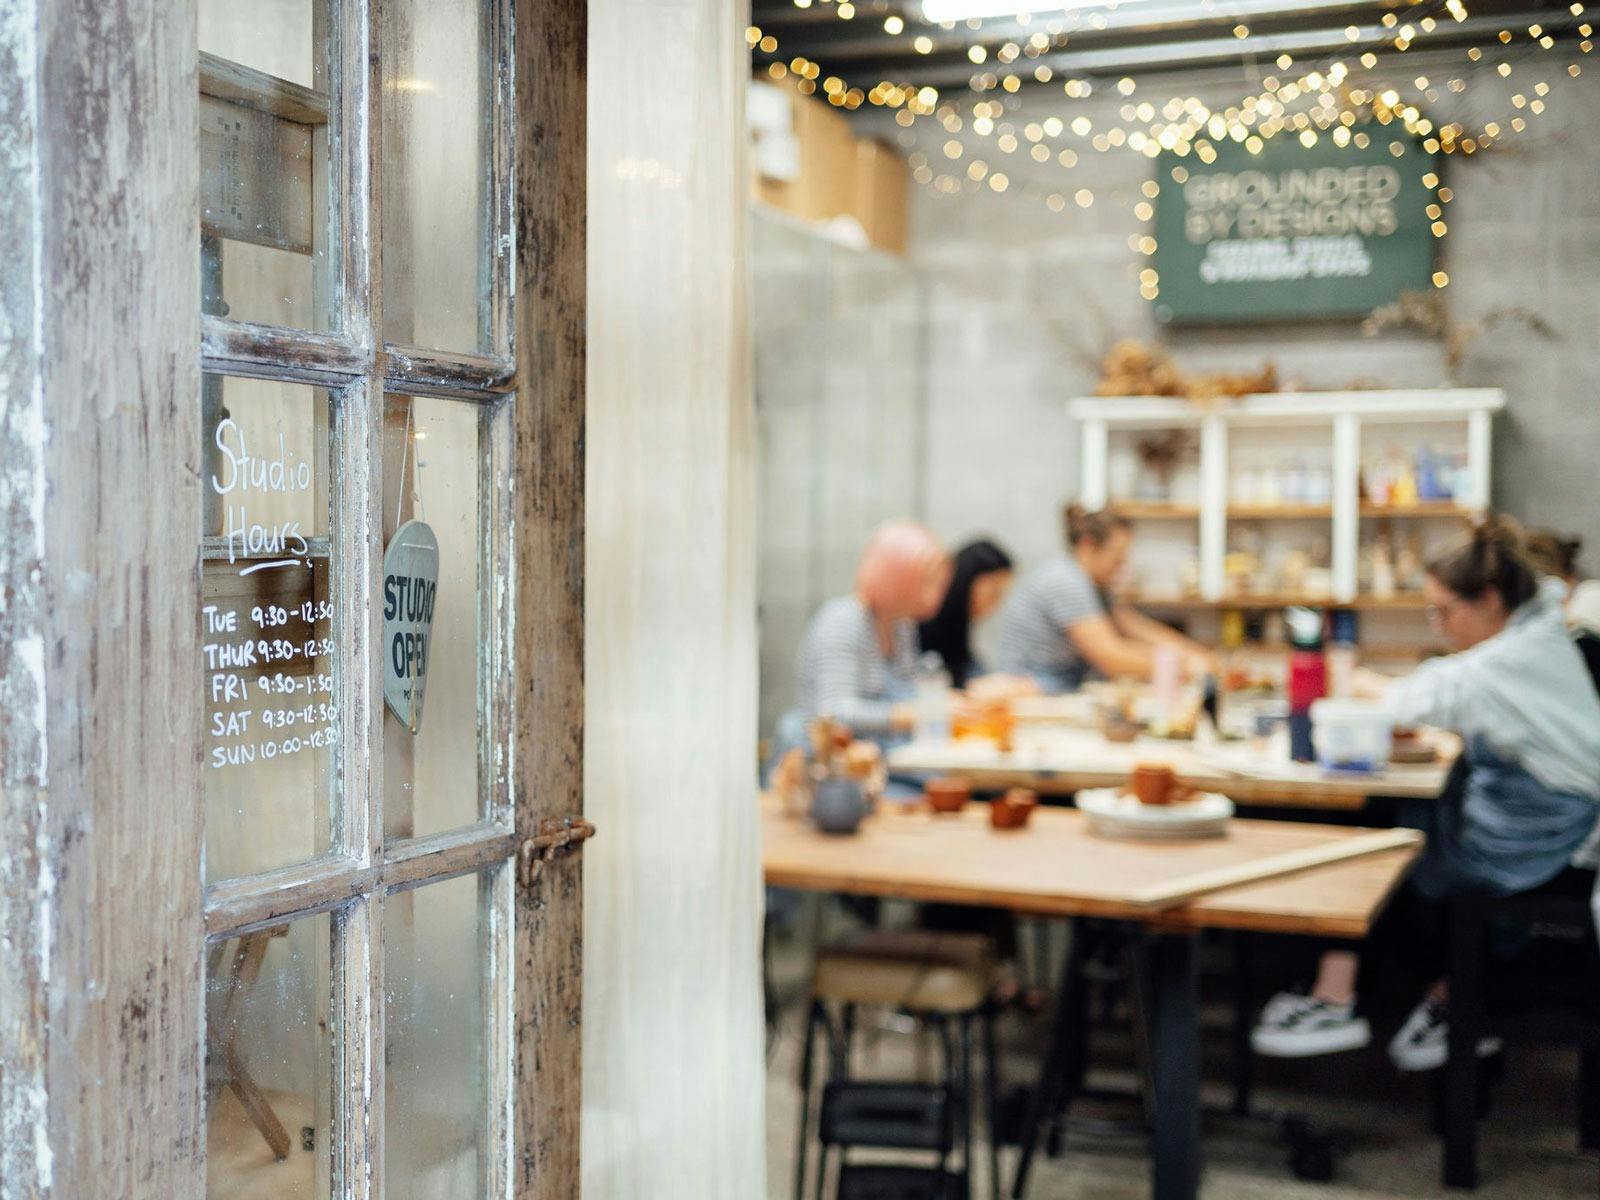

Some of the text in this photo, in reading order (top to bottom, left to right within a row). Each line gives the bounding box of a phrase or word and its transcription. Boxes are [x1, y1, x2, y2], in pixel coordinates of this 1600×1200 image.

[1184, 165, 1400, 210] GROUNDED
[1185, 205, 1236, 244] BY
[212, 418, 310, 495] Studio
[228, 505, 308, 564] Hours
[202, 605, 237, 634] TUE
[384, 575, 436, 625] STUDIO
[203, 640, 257, 669] THUR
[392, 632, 427, 678] OPEN
[212, 674, 248, 703] FRI
[211, 711, 252, 737] SAT
[212, 744, 255, 769] SUN
